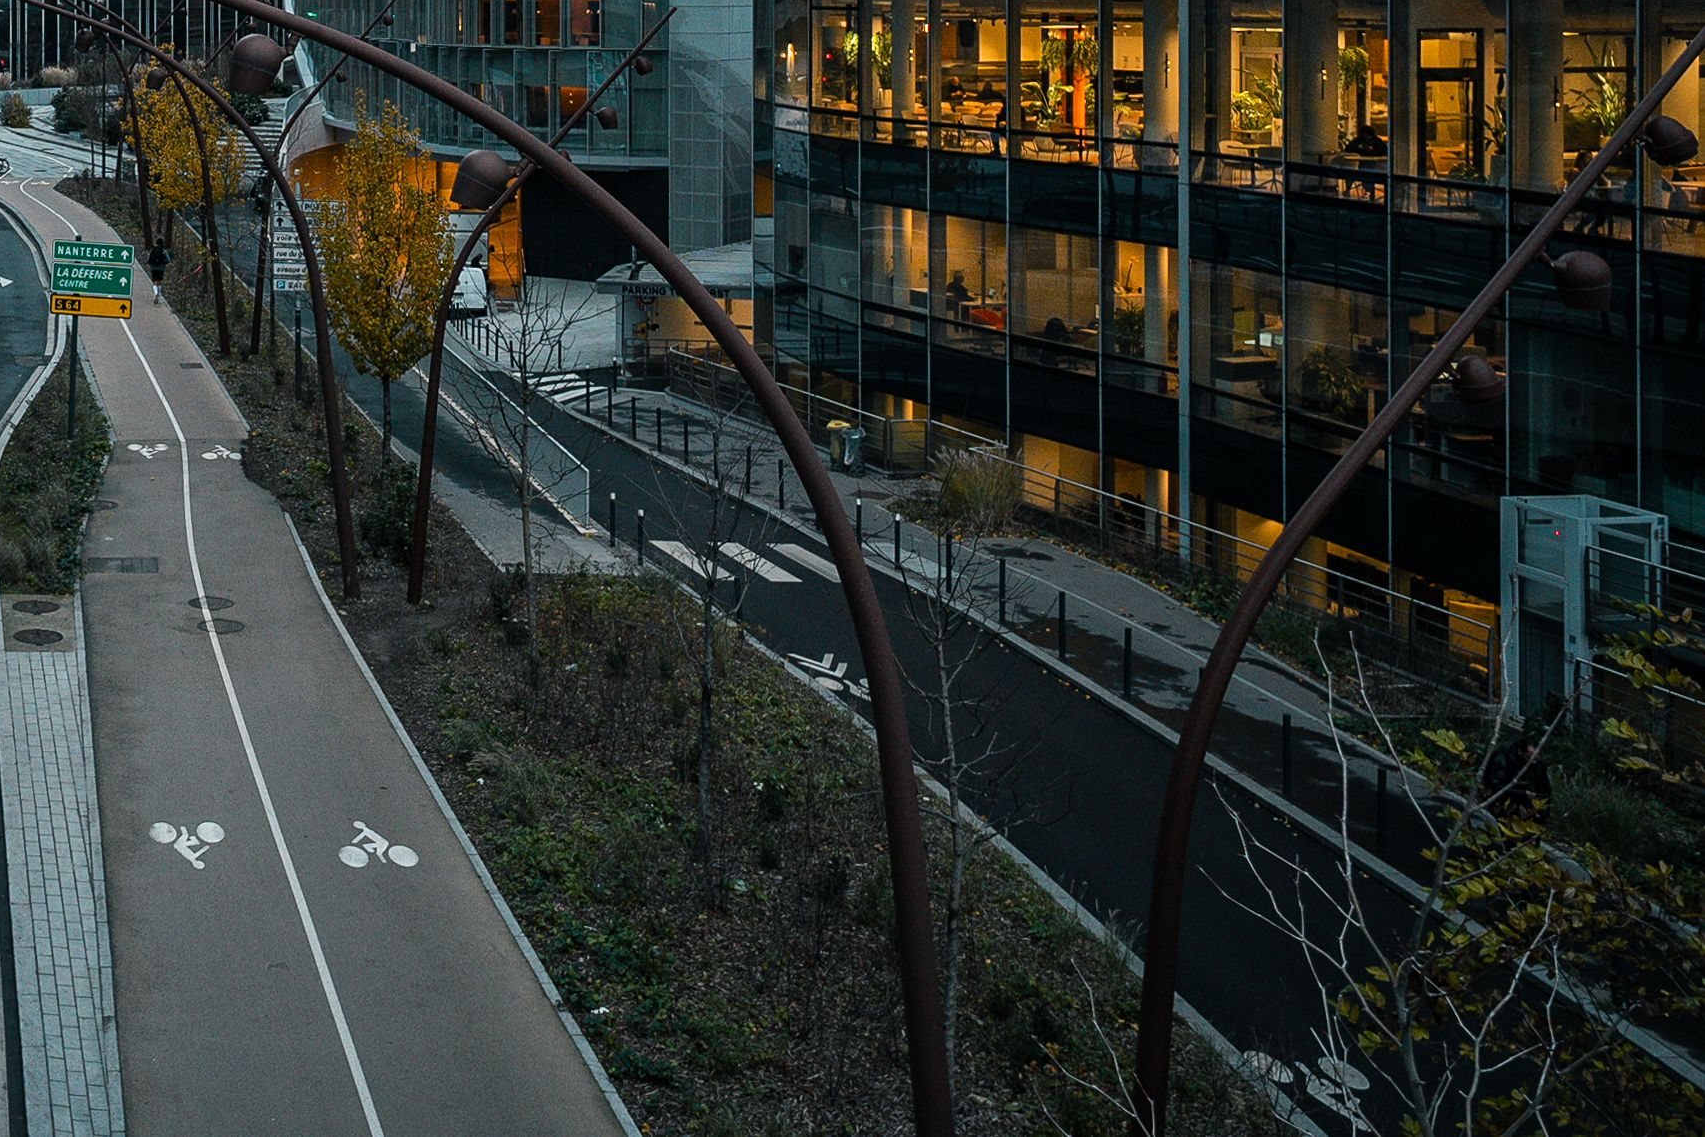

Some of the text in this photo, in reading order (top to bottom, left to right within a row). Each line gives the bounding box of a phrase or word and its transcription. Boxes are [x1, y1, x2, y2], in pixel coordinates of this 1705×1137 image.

[57, 246, 114, 258] NANTERRE
[56, 267, 114, 280] LA DÉFENSE
[622, 286, 666, 296] PARKING
[56, 300, 79, 310] S 64
